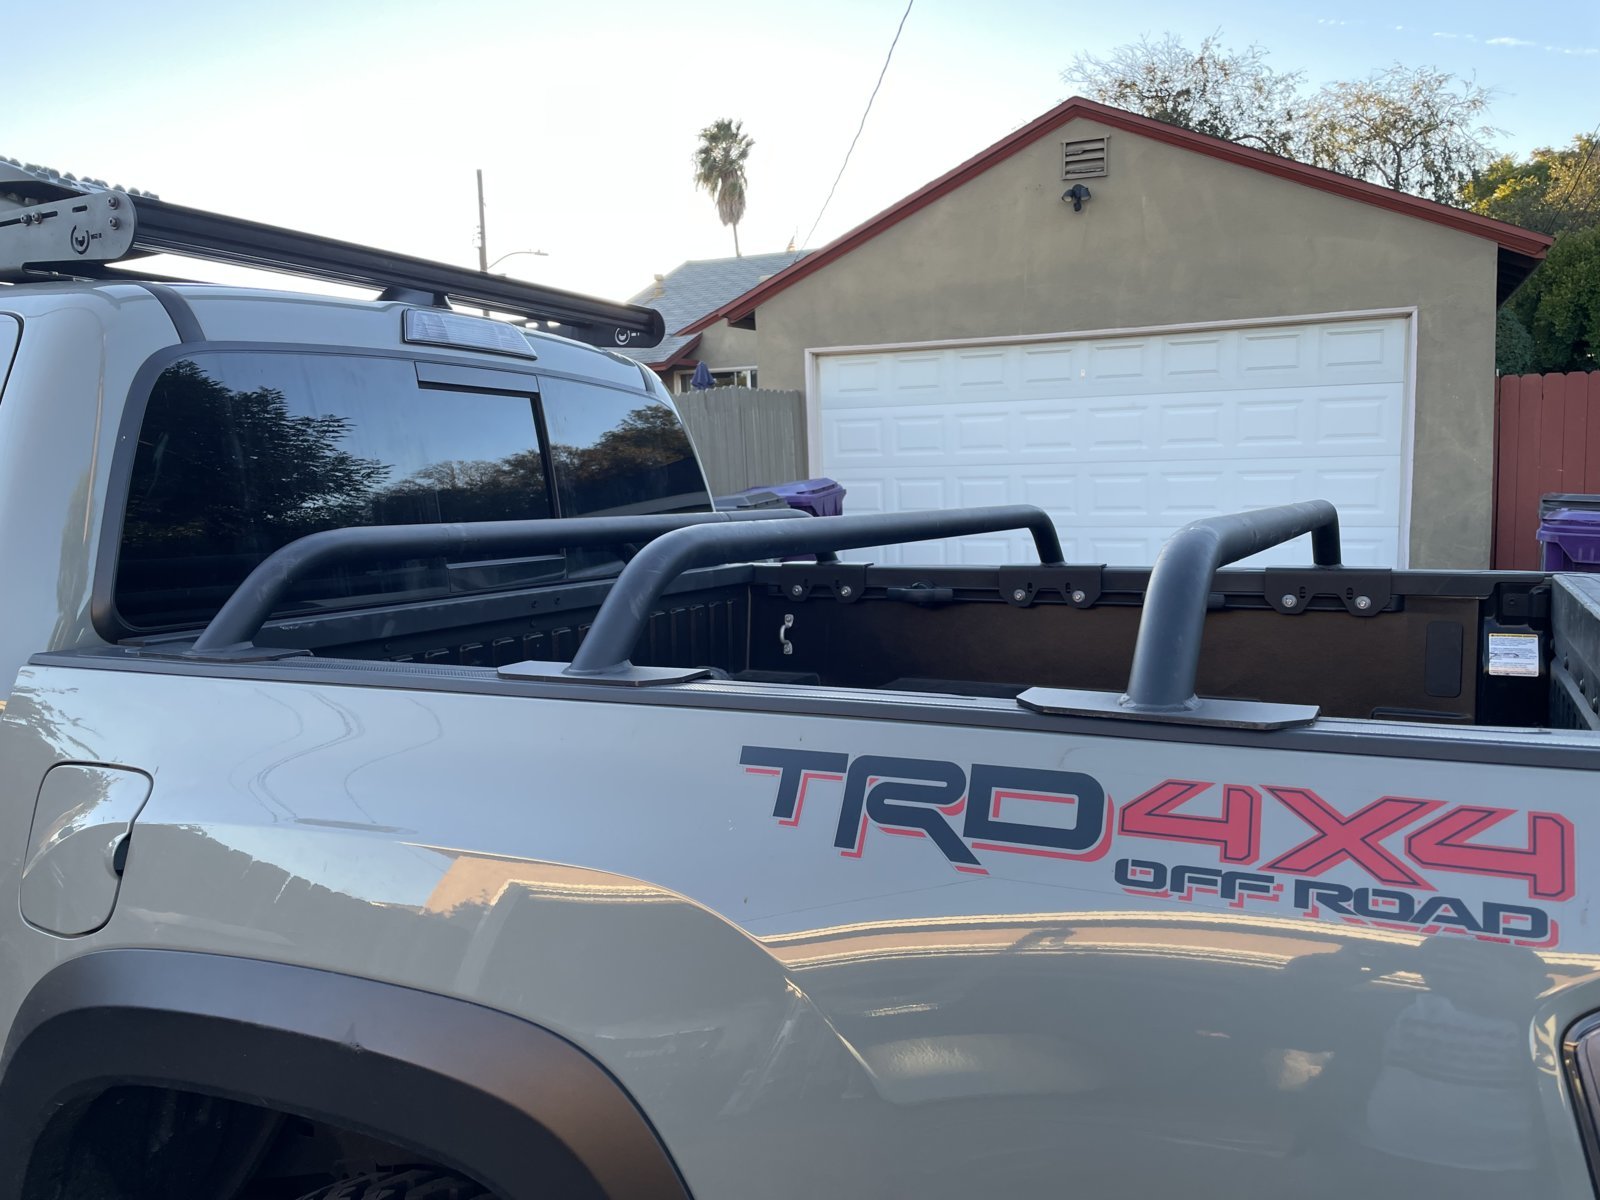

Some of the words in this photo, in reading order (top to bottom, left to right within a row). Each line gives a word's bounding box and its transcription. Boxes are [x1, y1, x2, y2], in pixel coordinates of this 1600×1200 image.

[740, 746, 1112, 875] TRD
[1114, 858, 1283, 908] OFF
[1294, 880, 1559, 947] ROAD
